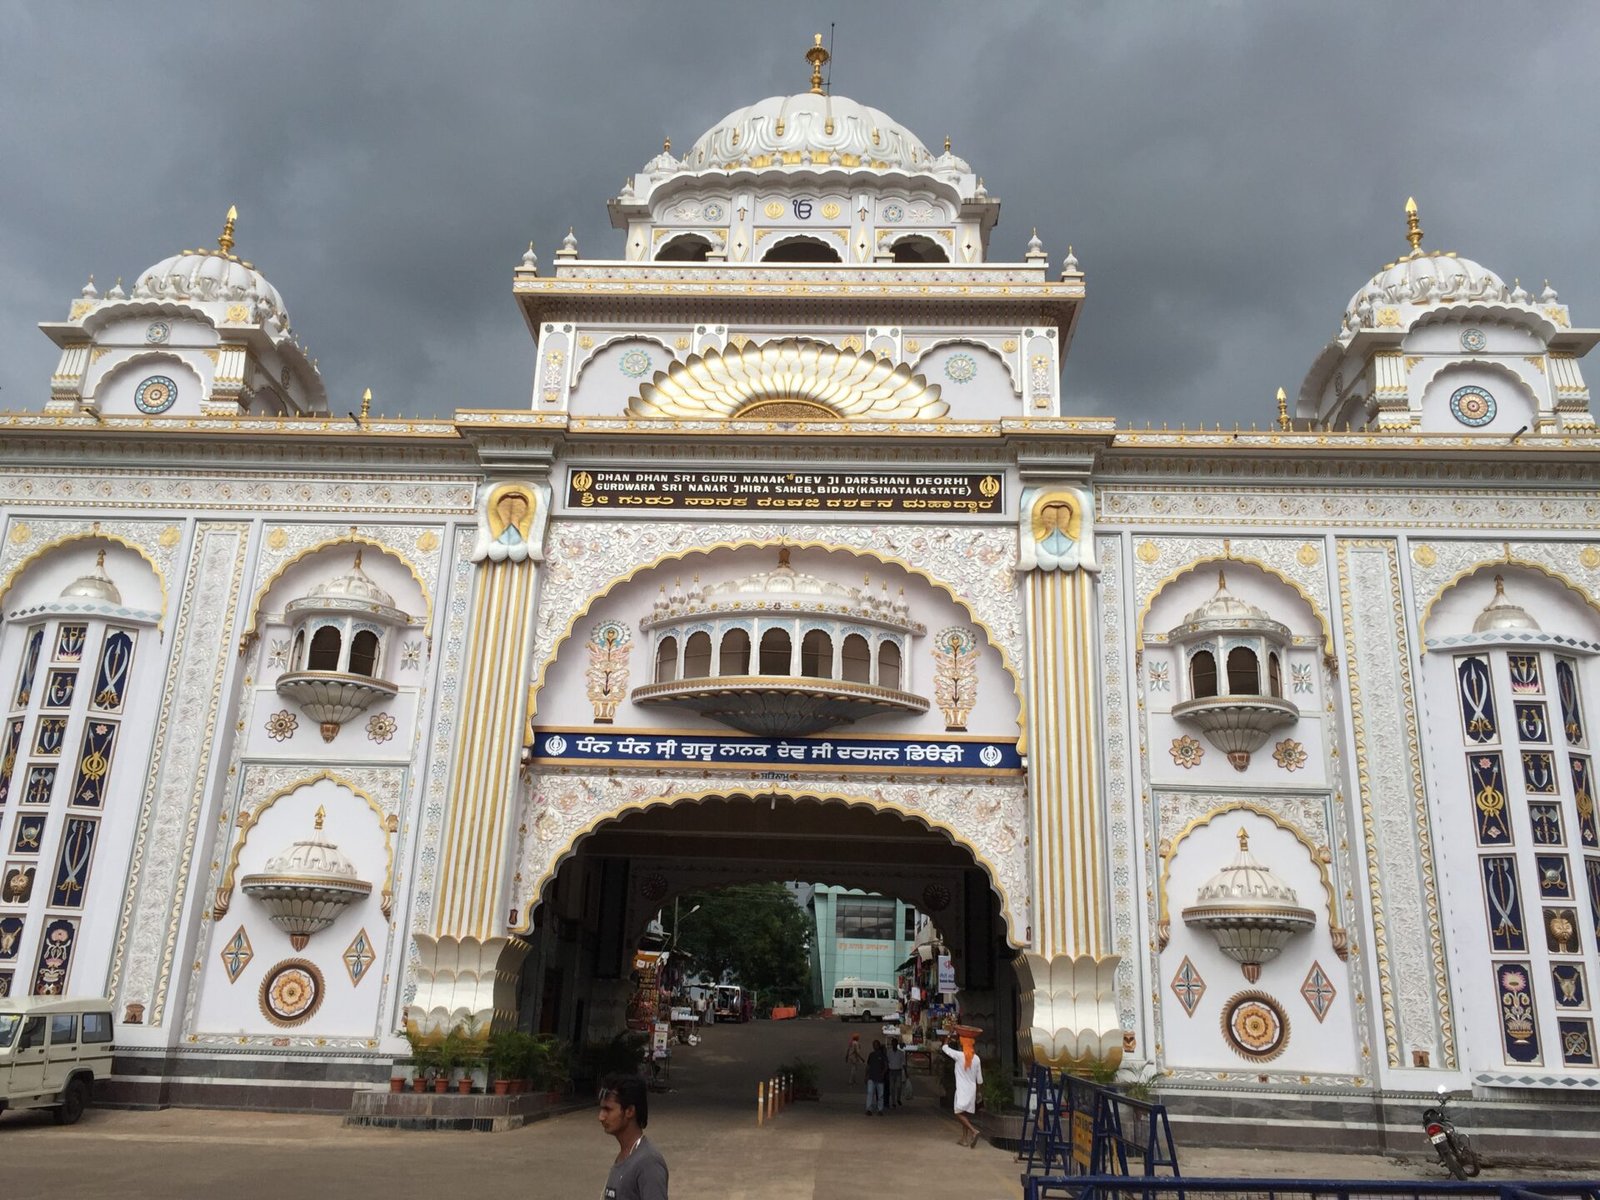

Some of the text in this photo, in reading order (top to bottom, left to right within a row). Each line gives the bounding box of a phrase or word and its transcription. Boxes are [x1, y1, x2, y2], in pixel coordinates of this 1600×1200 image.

[597, 473, 630, 482] DHAN
[635, 474, 668, 483] DHAN
[673, 474, 696, 483] SRI
[701, 474, 737, 483] GURU
[743, 475, 786, 484] NANAK
[795, 476, 822, 485] DEV
[827, 476, 839, 485] JI
[845, 476, 910, 486] DARSHANI
[915, 477, 969, 486] DEORHI
[595, 483, 972, 497] GURDWARA SRI NANAK JHIRA SAHEB, BIDAR (KARNATAKA STATE)
[581, 491, 609, 507] ಶ್ರೀ
[618, 494, 674, 505] ಗುರು
[684, 496, 748, 507] ನಾನಕ
[826, 498, 894, 509] ದರ್ಶನ
[902, 498, 994, 514] ಮಹಾದ್ವಾರ
[575, 736, 613, 753] ਧੰਨ
[616, 737, 652, 755] ਧੰਨ
[681, 743, 717, 761] ਗੁਰੂ
[719, 743, 771, 757] ਨਾਨਕ
[777, 741, 808, 759] ਦੇਵ
[811, 742, 833, 759] ਜੀ
[836, 746, 900, 761] ਦਰਸ਼ਨ
